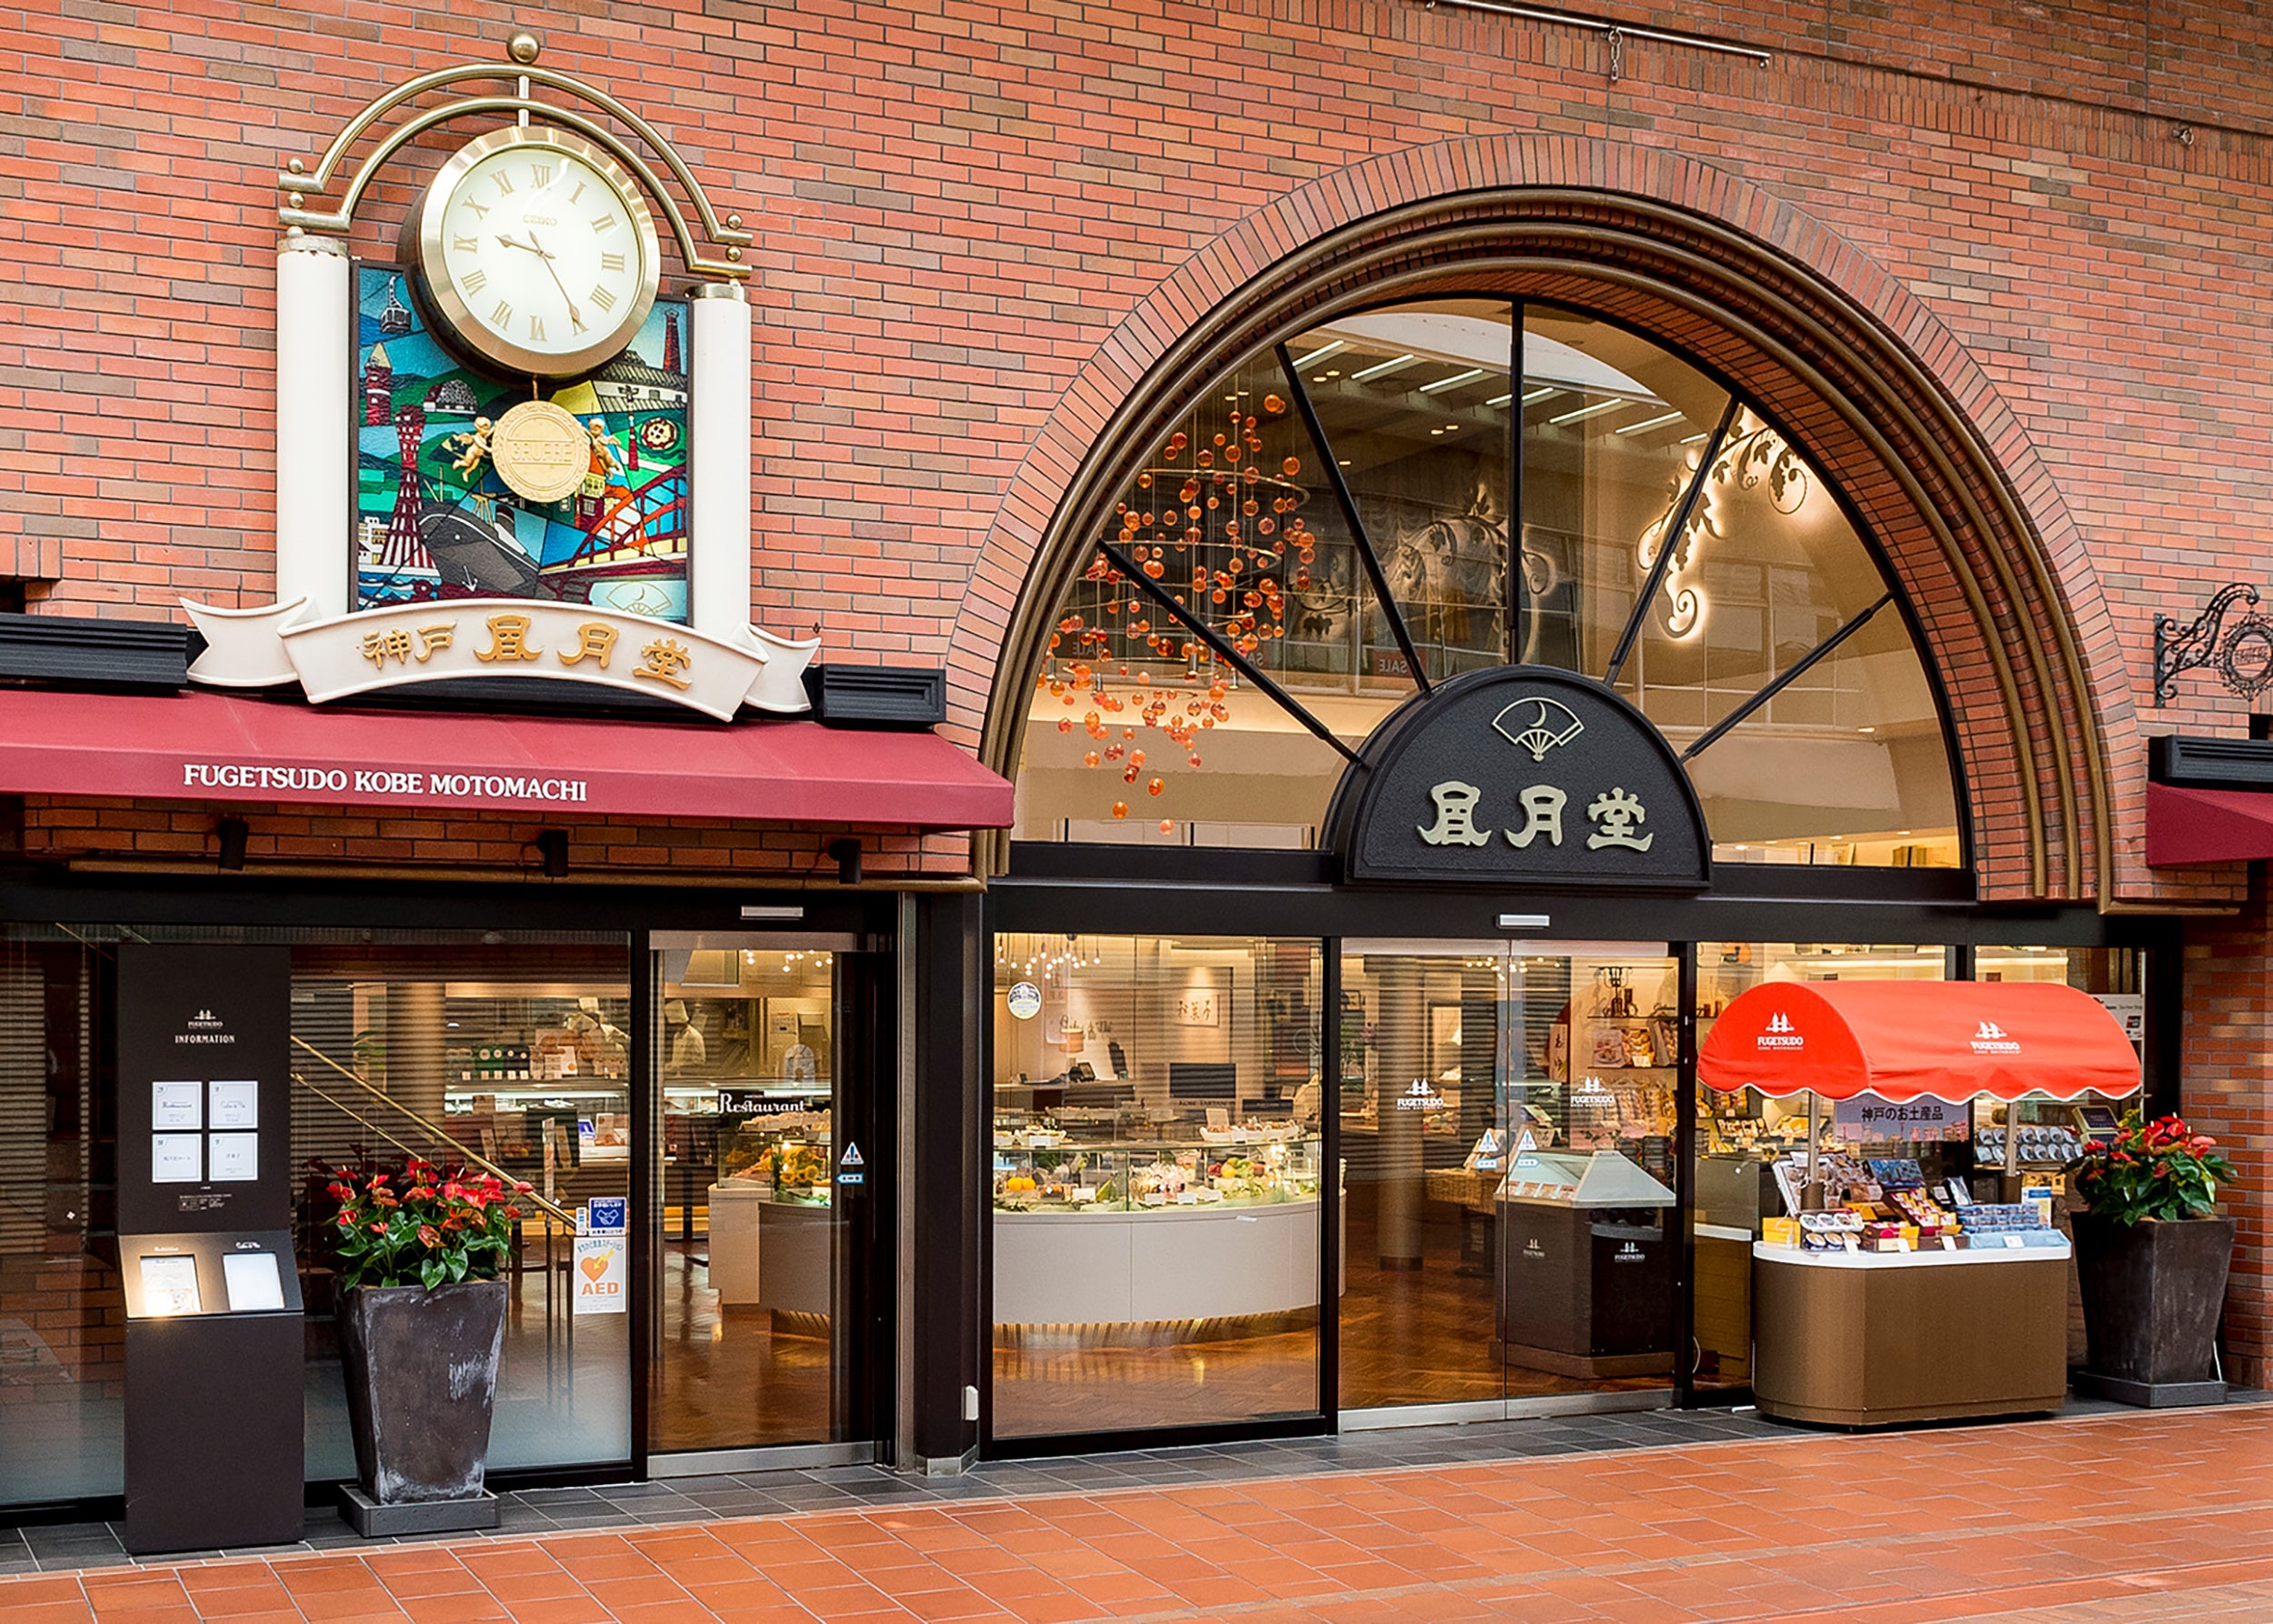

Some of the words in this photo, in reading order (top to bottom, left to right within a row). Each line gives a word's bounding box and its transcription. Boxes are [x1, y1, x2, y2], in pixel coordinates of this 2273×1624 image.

[184, 765, 347, 791] FUGETSUDO
[354, 771, 424, 795] KOBE
[429, 774, 587, 801] MOTOMACHI
[175, 1035, 235, 1044] INFORMATION
[1757, 1036, 1804, 1046] FUGETSUDO
[1969, 1041, 2020, 1050] FUGETSUDO
[719, 1093, 806, 1114] Restaurant
[1397, 1098, 1444, 1107] FUGETSUDO
[1571, 1095, 1615, 1104] FUGETSUDO
[1861, 1106, 1944, 1122] 神戸のお土産品
[582, 1282, 619, 1295] AED
